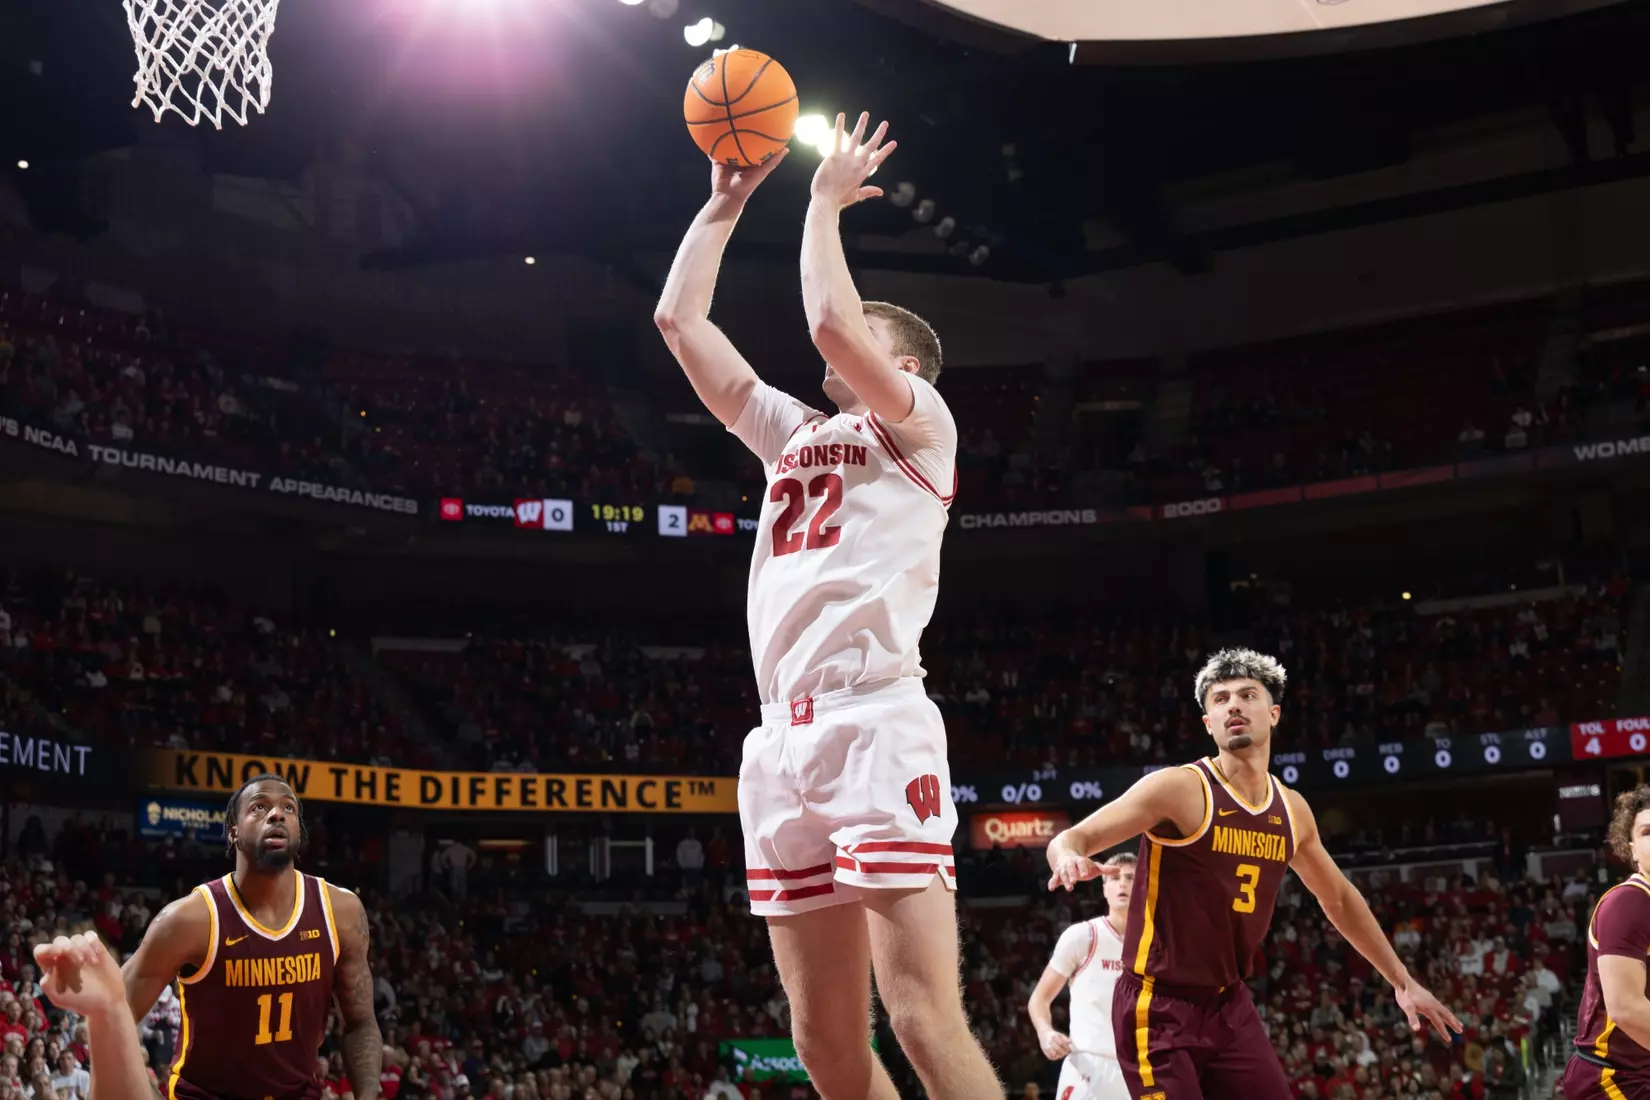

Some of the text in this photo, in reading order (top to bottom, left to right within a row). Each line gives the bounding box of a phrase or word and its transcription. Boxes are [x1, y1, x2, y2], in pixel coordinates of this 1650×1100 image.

[0, 416, 418, 515] 'S NCAA TOURNAMENT APPEARANCES
[464, 504, 516, 519] TOYOTA
[552, 508, 564, 522] 0
[591, 503, 645, 523] 19:19
[770, 473, 843, 557] 22
[1163, 498, 1222, 518] 2000
[605, 521, 629, 533] 1ST
[668, 514, 679, 529] 2
[960, 509, 1097, 529] CHAMPIONS
[1578, 721, 1605, 736] TOL
[1529, 741, 1546, 760] 0
[1584, 736, 1603, 756] 4
[1629, 732, 1647, 752] 0
[1383, 755, 1400, 774] 0
[1434, 750, 1452, 769] 0
[1483, 745, 1501, 765] 0
[176, 753, 310, 794] KNOW
[330, 767, 400, 801] THE
[1282, 765, 1299, 784] 0
[1333, 760, 1350, 779] 0
[951, 781, 1103, 804] 0% 0/0 0%
[985, 817, 1055, 843] Quartz
[1211, 824, 1287, 863] MINNESOTA
[1232, 863, 1260, 914] 3
[225, 953, 321, 988] MINNESOTA
[255, 992, 294, 1046] 11
